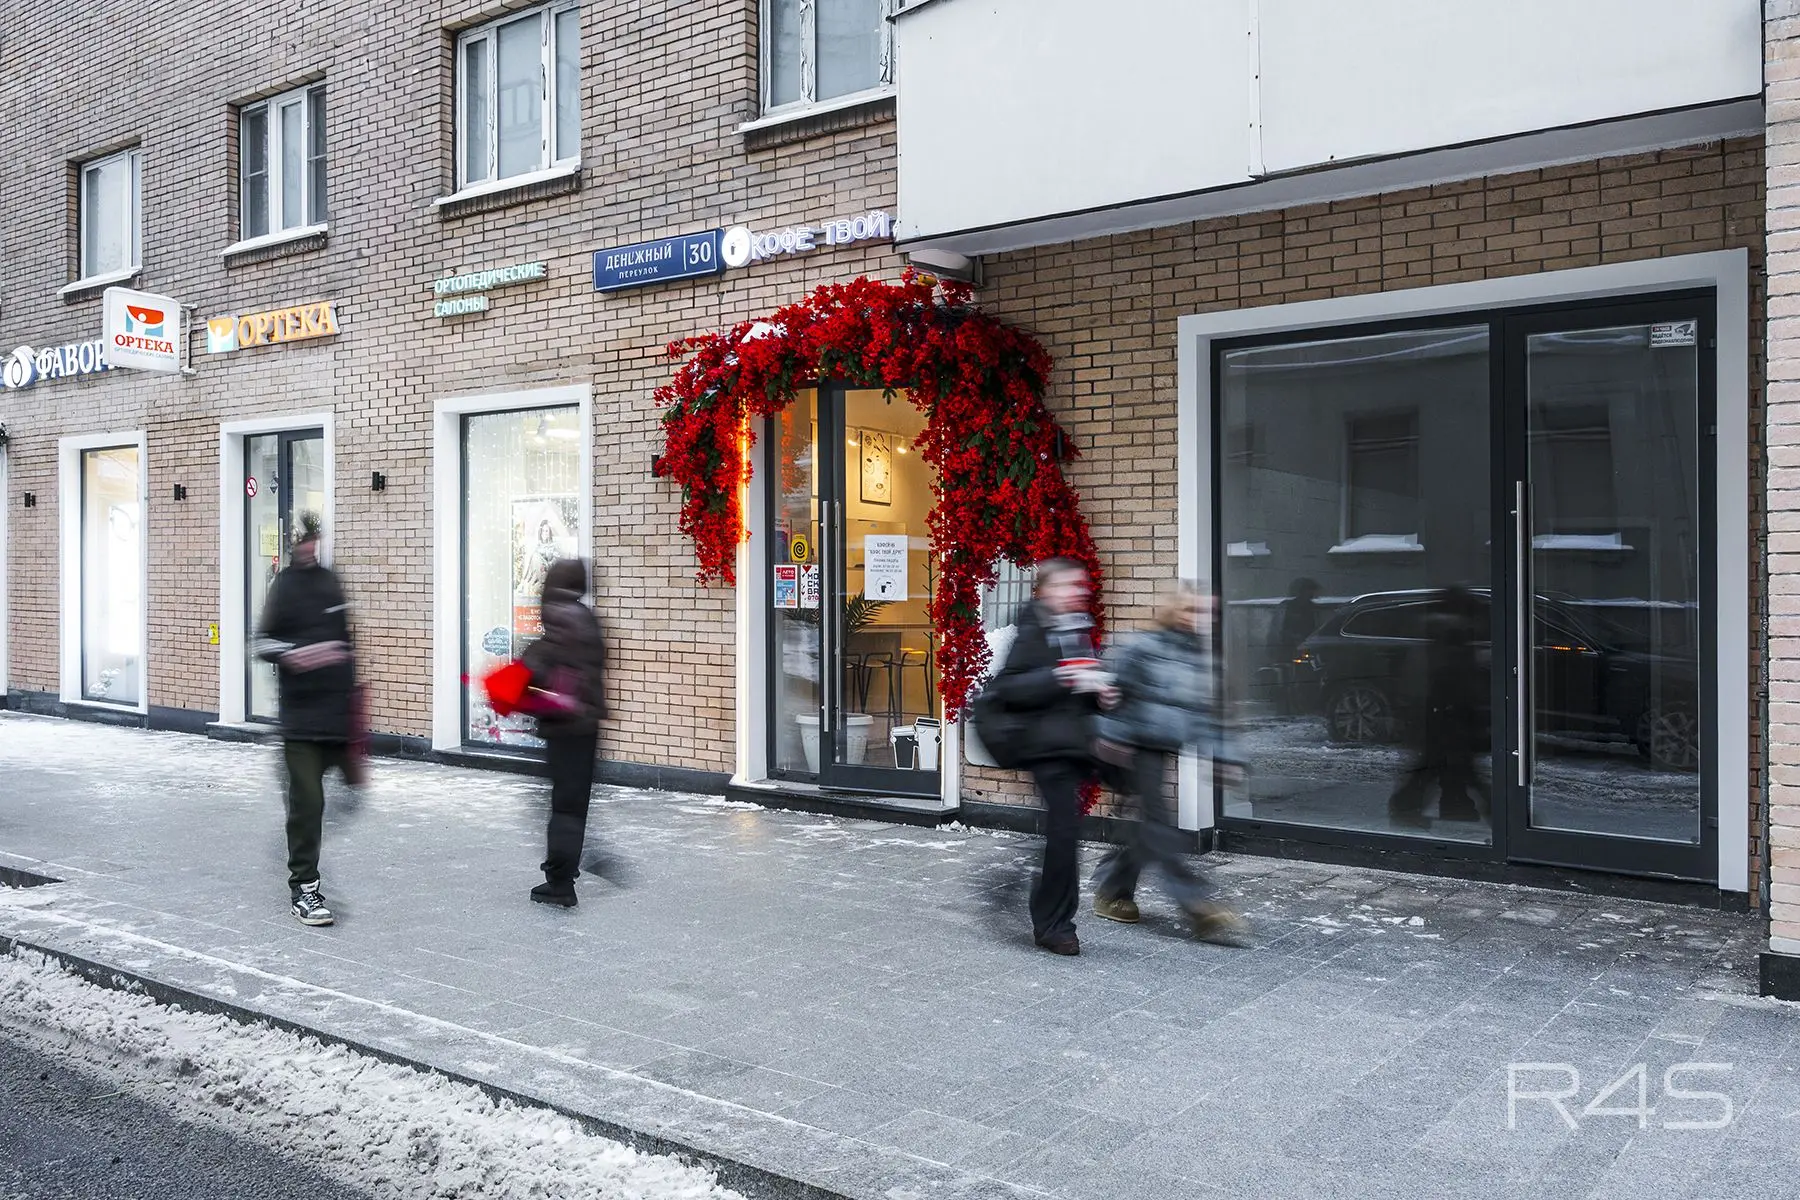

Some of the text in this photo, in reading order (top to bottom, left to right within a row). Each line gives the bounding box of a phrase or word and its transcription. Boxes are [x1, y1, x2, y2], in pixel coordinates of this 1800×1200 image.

[751, 227, 813, 259] КОФЕ
[822, 210, 887, 245] ТВОЙ
[689, 241, 711, 264] 30
[434, 261, 544, 294] ОРТОПЕДИЧЕСКИЕ
[619, 266, 658, 279] ПЕРЕУЛОК
[434, 296, 486, 317] САЛОНЫ
[238, 301, 336, 347] ОРТЕКА
[115, 334, 175, 353] ОРТЕКА
